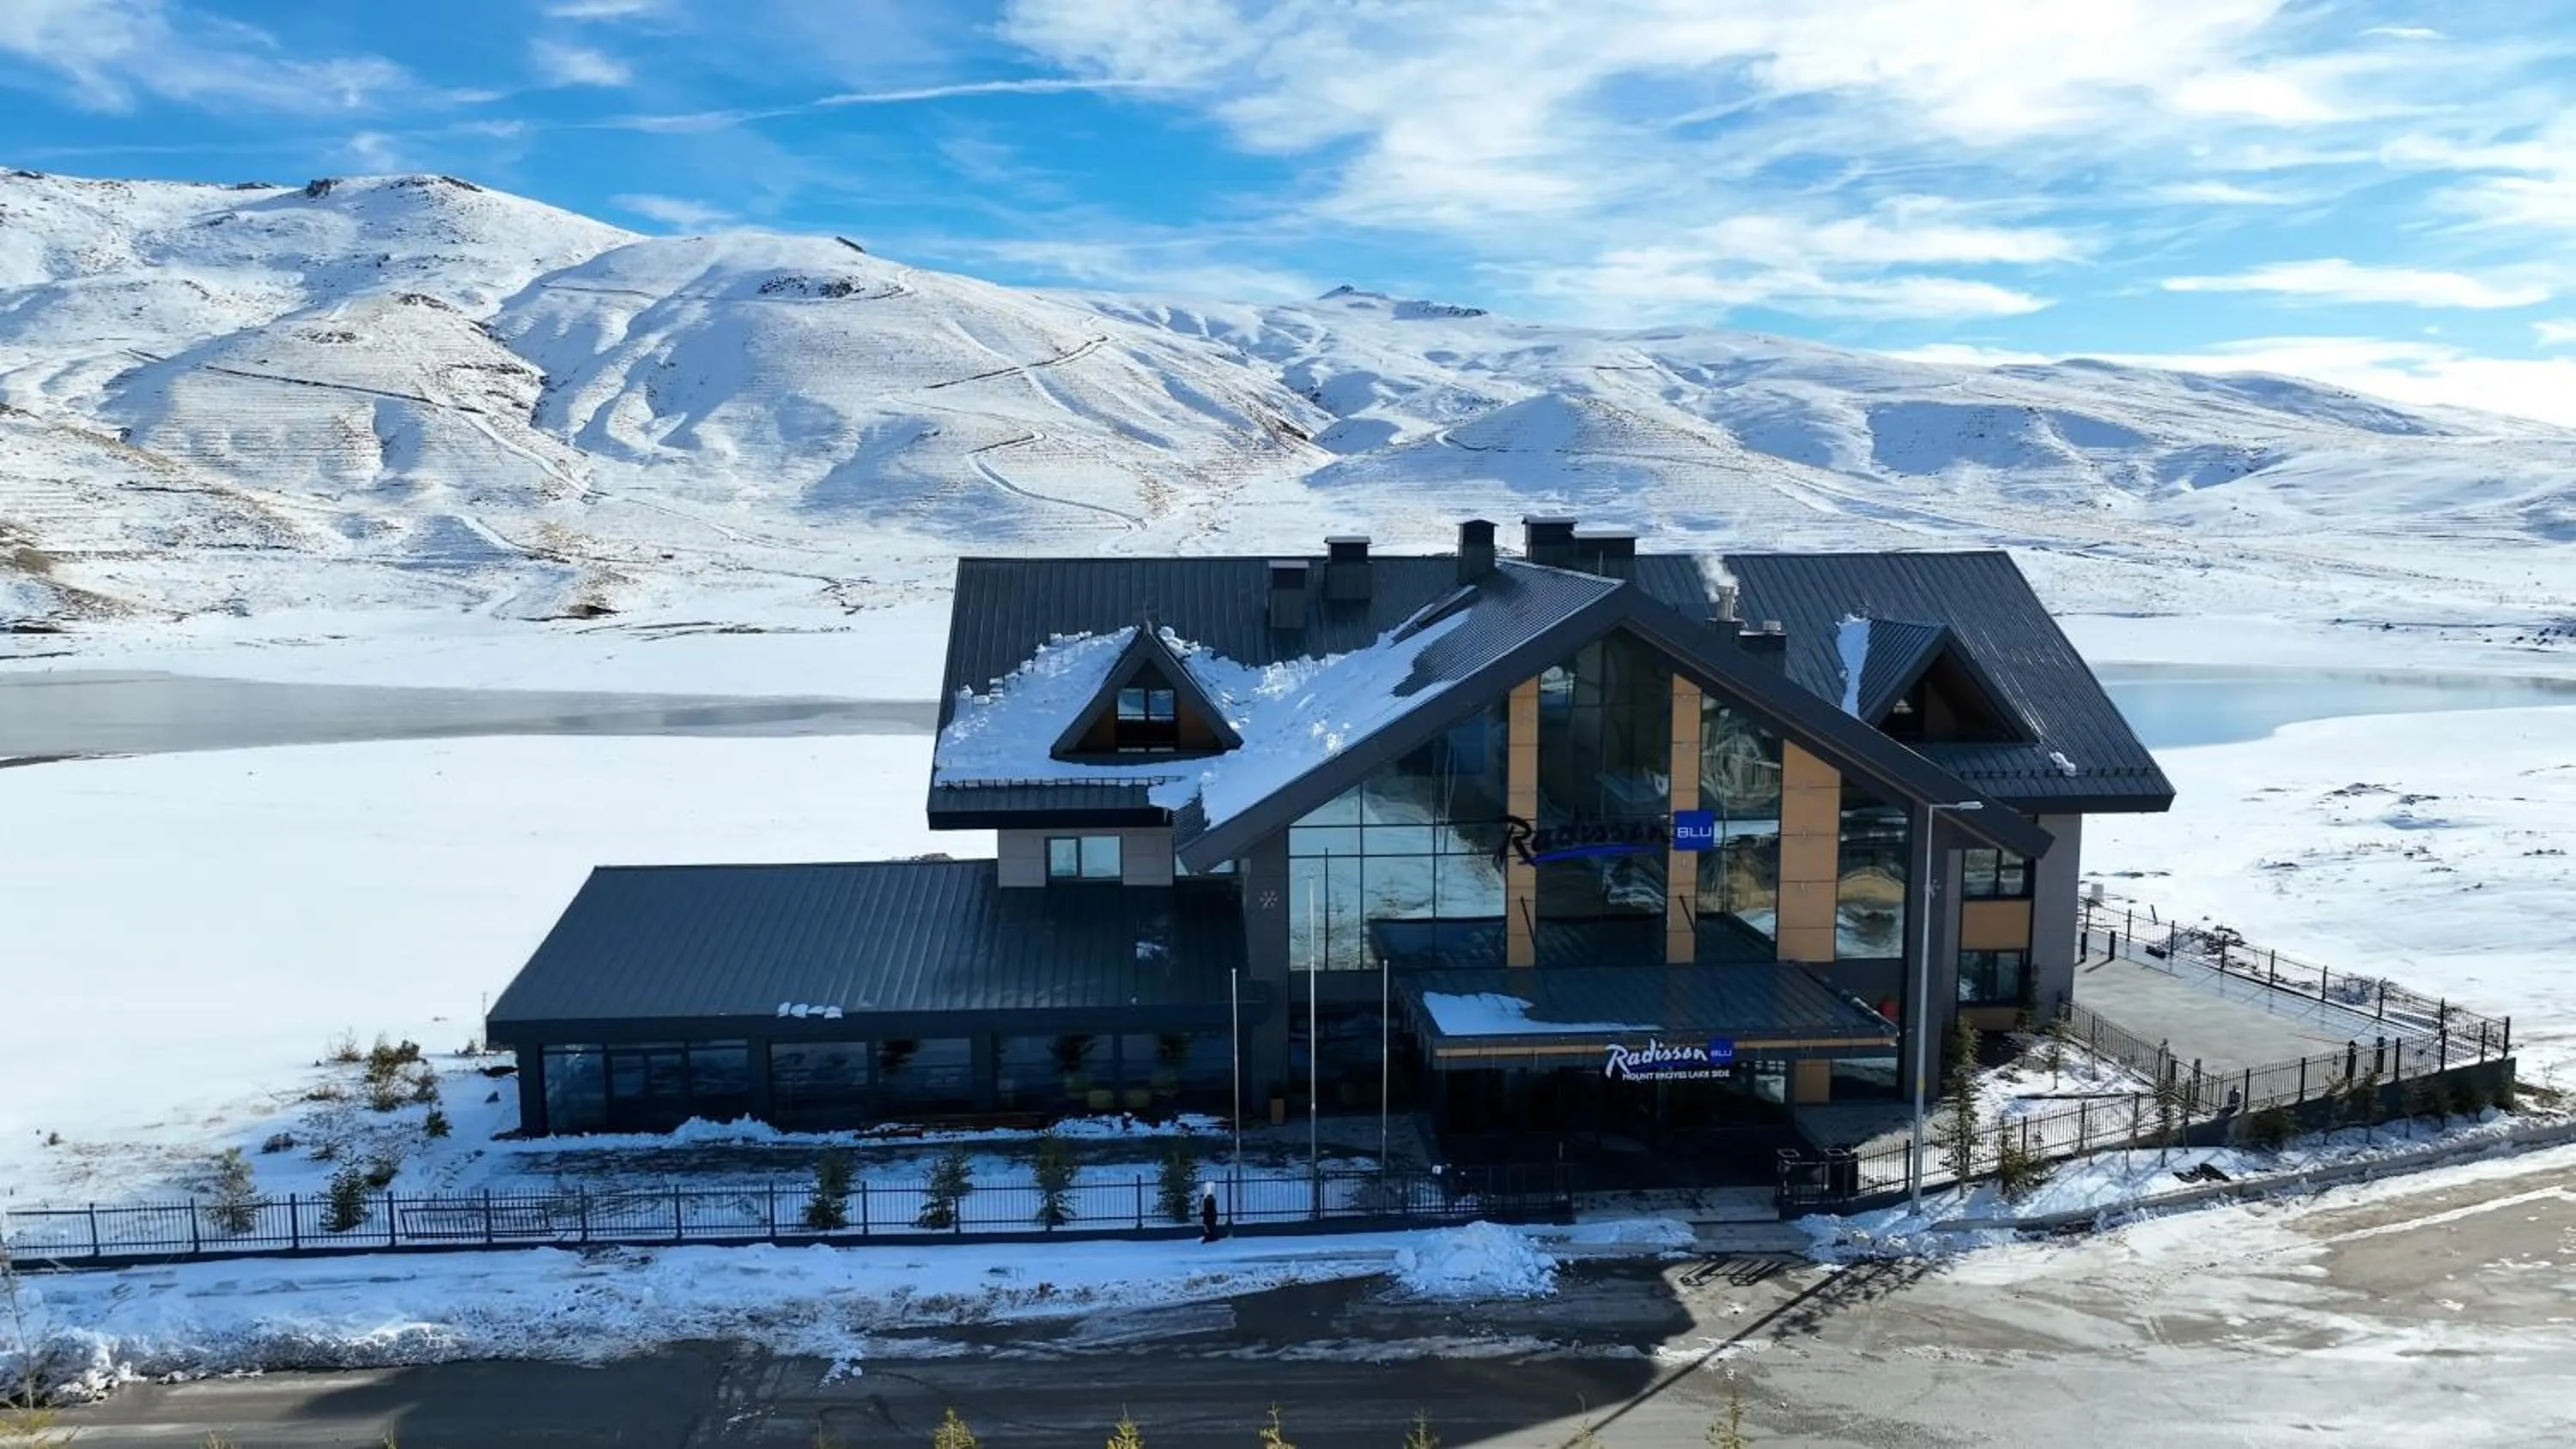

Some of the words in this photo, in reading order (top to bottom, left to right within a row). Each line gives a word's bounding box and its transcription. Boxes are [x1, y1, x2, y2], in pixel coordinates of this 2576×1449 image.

[1676, 826, 1713, 839] BLU
[1605, 1037, 1708, 1079] Radisson
[1710, 1049, 1733, 1058] BLU
[1622, 1072, 1653, 1082] MOUNT
[1688, 1070, 1710, 1079] LAKE
[1711, 1070, 1730, 1078] SIDE
